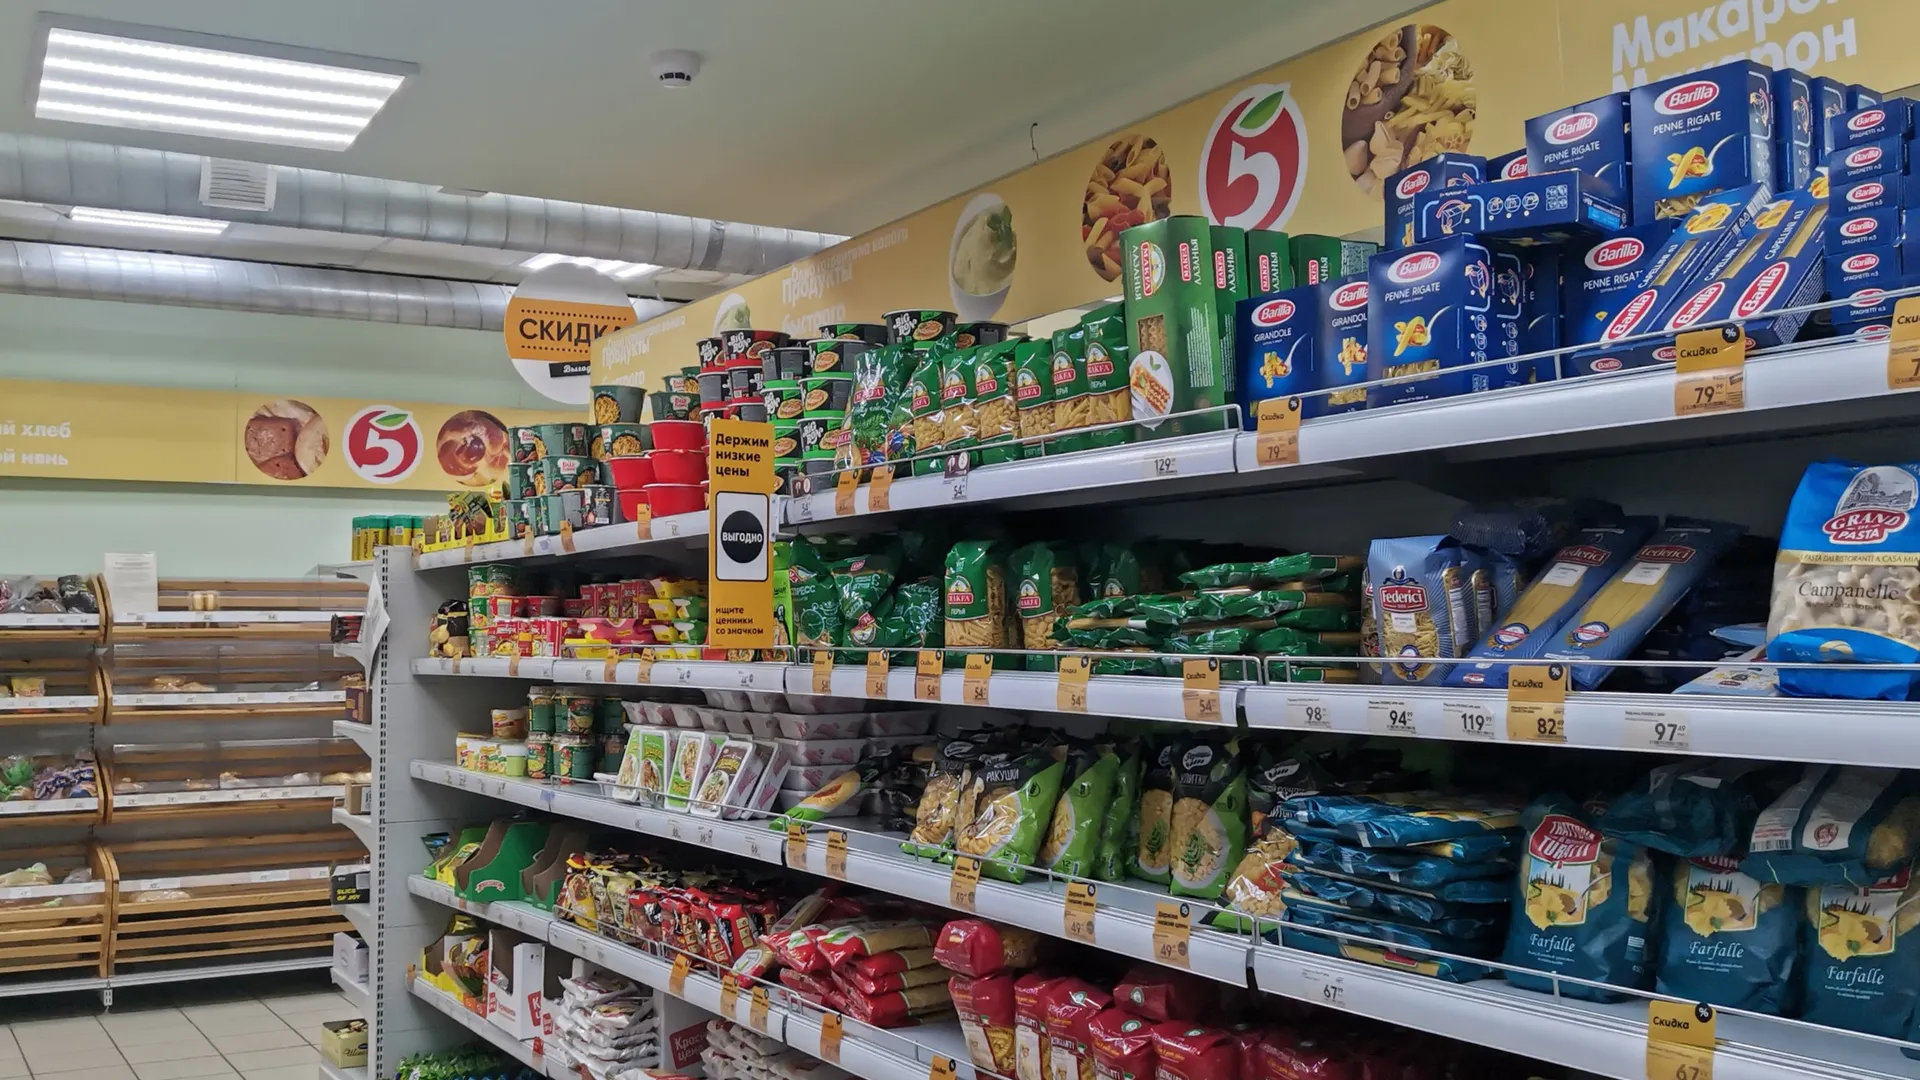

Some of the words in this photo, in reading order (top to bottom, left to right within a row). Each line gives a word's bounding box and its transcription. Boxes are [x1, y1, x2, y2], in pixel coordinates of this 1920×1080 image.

[1667, 84, 1713, 109] Barilla
[1556, 114, 1595, 138] Barilla
[1653, 120, 1684, 135] PENNE
[1687, 110, 1721, 128] RIGATE
[1856, 112, 1882, 127] Barilla
[1849, 129, 1876, 140] SPAGHETTI
[1544, 150, 1569, 164] PENNE
[1571, 140, 1600, 158] RIGATE
[1853, 149, 1879, 164] Barilla
[1403, 172, 1427, 191] Barilla
[1854, 186, 1880, 199] Barilla
[1848, 202, 1874, 212] SPAGHETTI
[1848, 221, 1875, 233] Barilla
[1596, 242, 1638, 266] Barilla
[1401, 256, 1437, 276] Barilla
[1849, 256, 1877, 269] Barilla
[1583, 276, 1612, 291] PENNE
[1613, 269, 1644, 288] RIGAT
[1385, 290, 1410, 302] PENNE
[1412, 282, 1441, 297] RIGATE
[1740, 264, 1786, 318] Barilla
[1261, 303, 1293, 322] Barilla
[1672, 283, 1723, 328] Barilla
[1850, 307, 1877, 316] SPAGHETTI
[1331, 312, 1368, 328] GIRANDOL
[1614, 290, 1656, 341] Barilla
[519, 318, 622, 347] СКИДК
[1254, 327, 1292, 343] GIRANDOLE
[1680, 346, 1719, 358] Скидка
[1694, 386, 1715, 404] 79
[20, 421, 72, 438] хлеб
[715, 433, 769, 448] Держим
[715, 451, 761, 463] низкие
[1267, 446, 1280, 460] 79
[715, 467, 750, 478] цены
[1154, 458, 1171, 475] 129
[1830, 511, 1903, 529] GRAND
[722, 532, 763, 544] ВЫГОДНО
[1838, 529, 1880, 541] PASTA
[1881, 555, 1901, 563] CASA
[1383, 589, 1423, 603] Federici
[1799, 581, 1899, 601] Campanelle
[715, 606, 745, 615] ищите
[715, 617, 753, 625] ценники
[715, 627, 726, 635] со
[727, 627, 764, 635] значком
[1512, 678, 1544, 689] Скидка
[974, 687, 984, 699] 54
[1071, 694, 1081, 706] 54
[1200, 699, 1212, 712] 54
[1306, 706, 1322, 721] 98
[1389, 710, 1407, 726] 94
[1461, 713, 1485, 731] 119
[1537, 717, 1557, 735] 82
[1655, 723, 1677, 741] 97
[1070, 922, 1081, 933] 49
[1160, 944, 1172, 957] 49
[1530, 933, 1575, 953] Farfalle
[1689, 941, 1744, 960] Farfalle
[1826, 965, 1885, 987] Farfalle
[1323, 986, 1338, 1000] 67
[1653, 1016, 1690, 1030] Скидка
[1675, 1063, 1701, 1080] 67
